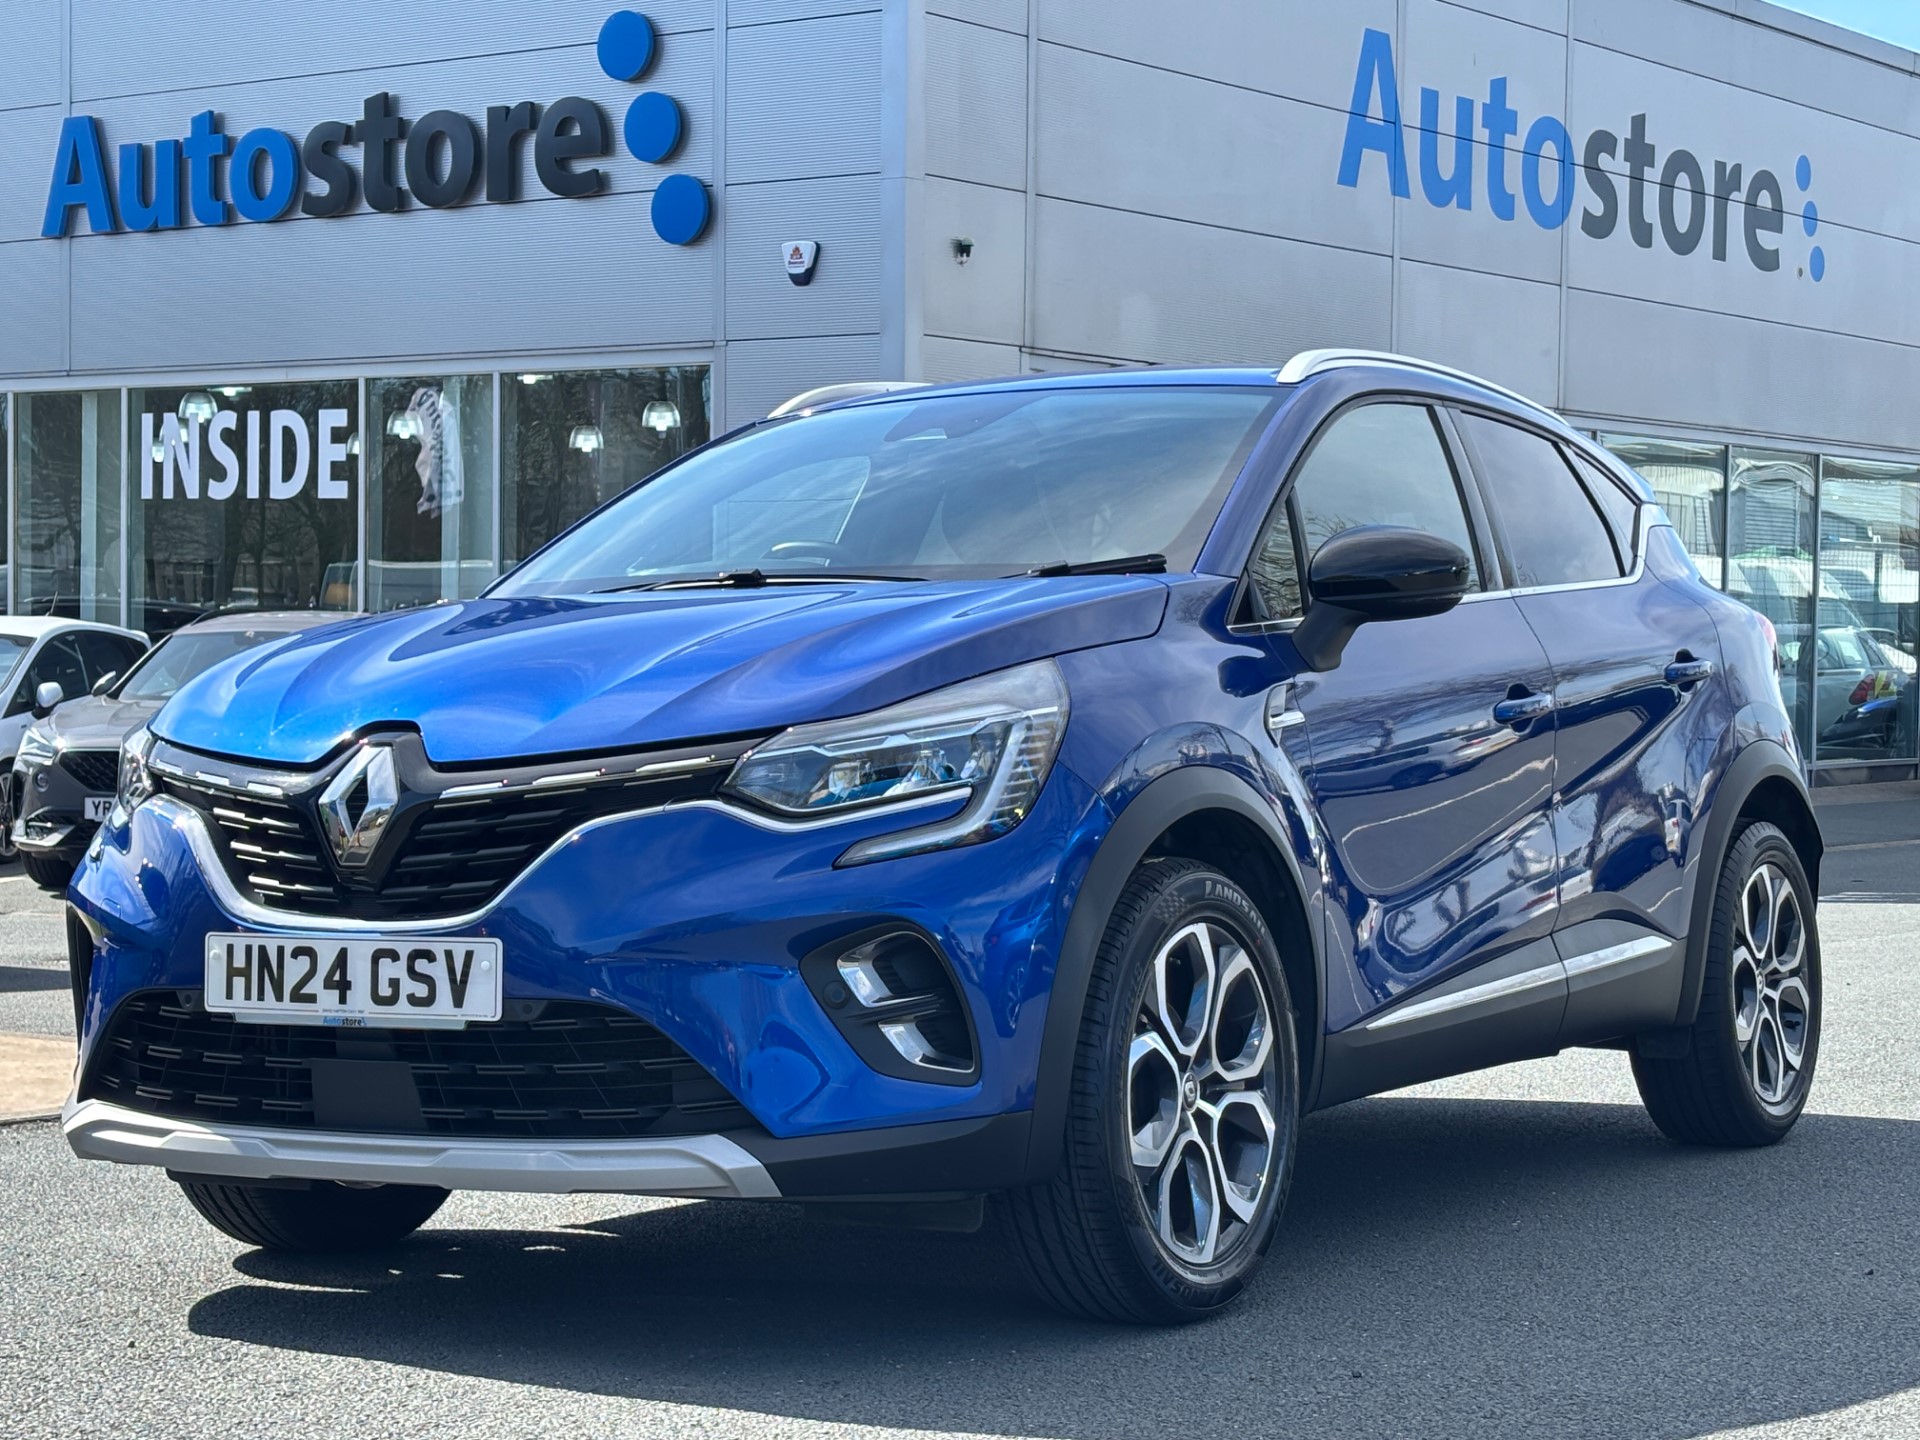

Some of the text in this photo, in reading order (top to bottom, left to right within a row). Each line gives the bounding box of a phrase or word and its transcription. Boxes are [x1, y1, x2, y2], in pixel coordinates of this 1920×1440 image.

[41, 91, 610, 238] Autostore
[1337, 27, 1784, 272] Autostore
[140, 407, 349, 500] INSIDE
[1204, 880, 1266, 936] LANDSAIL
[225, 943, 475, 1009] HN24 GSV
[322, 1015, 362, 1026] Autostore
